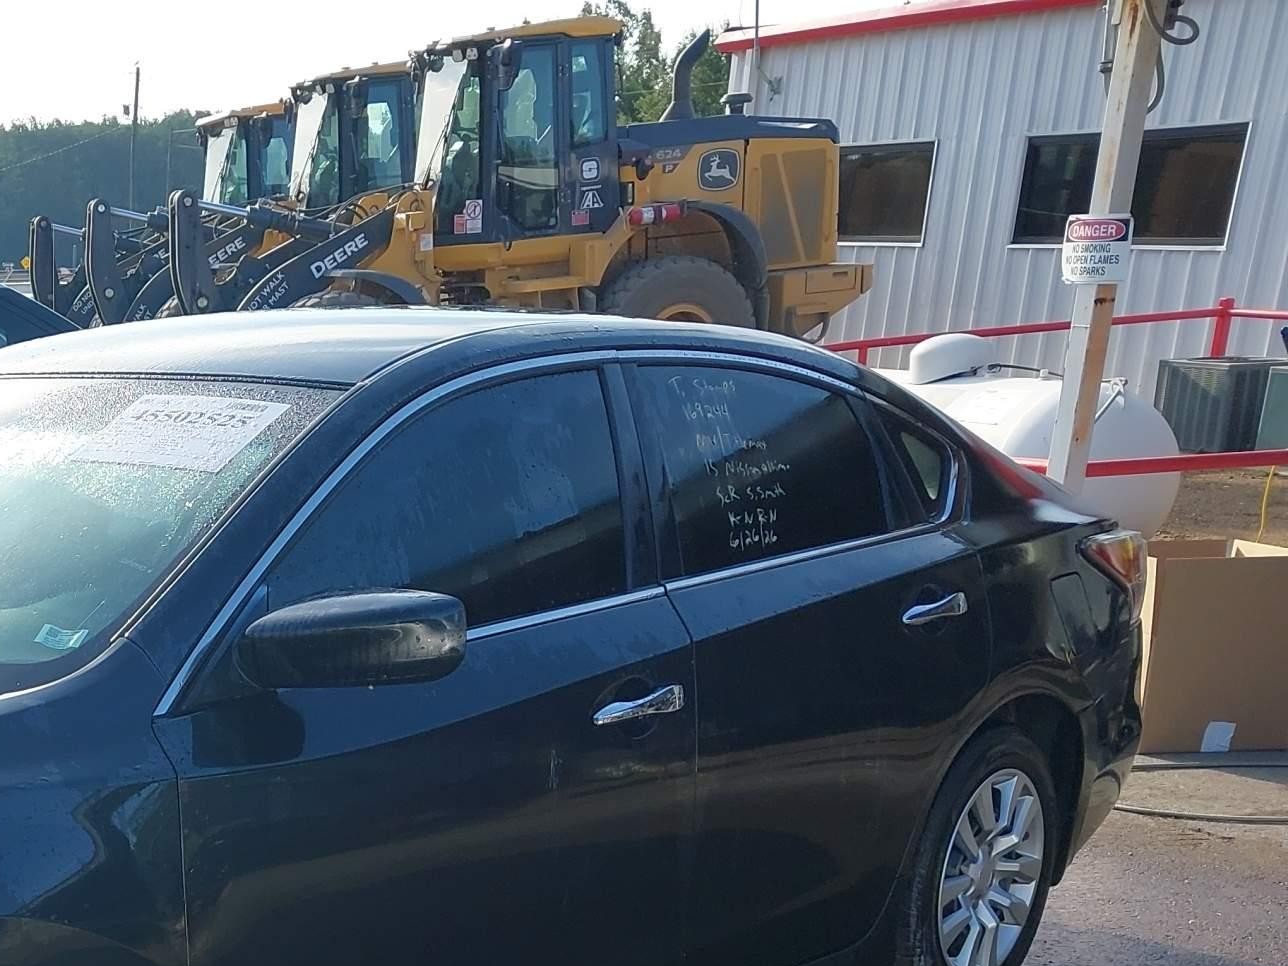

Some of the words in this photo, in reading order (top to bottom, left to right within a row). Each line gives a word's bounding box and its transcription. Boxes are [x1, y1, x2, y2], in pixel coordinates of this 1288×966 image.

[655, 148, 682, 160] 624
[664, 164, 674, 173] P
[1072, 224, 1117, 237] DANGER
[207, 236, 246, 266] EERE
[310, 232, 369, 279] DEERE
[1072, 244, 1080, 253] NO
[1081, 243, 1111, 253] SMOKING
[1065, 256, 1072, 265] NO
[1073, 255, 1089, 265] OPEN
[1089, 254, 1120, 265] FLAMES
[1071, 267, 1078, 276] NO
[1079, 266, 1106, 276] SPARKS
[261, 271, 286, 296] WALK
[268, 281, 290, 306] MAST
[81, 300, 94, 315] UND
[131, 409, 254, 429] 45502525
[728, 528, 778, 552] 6/26/26
